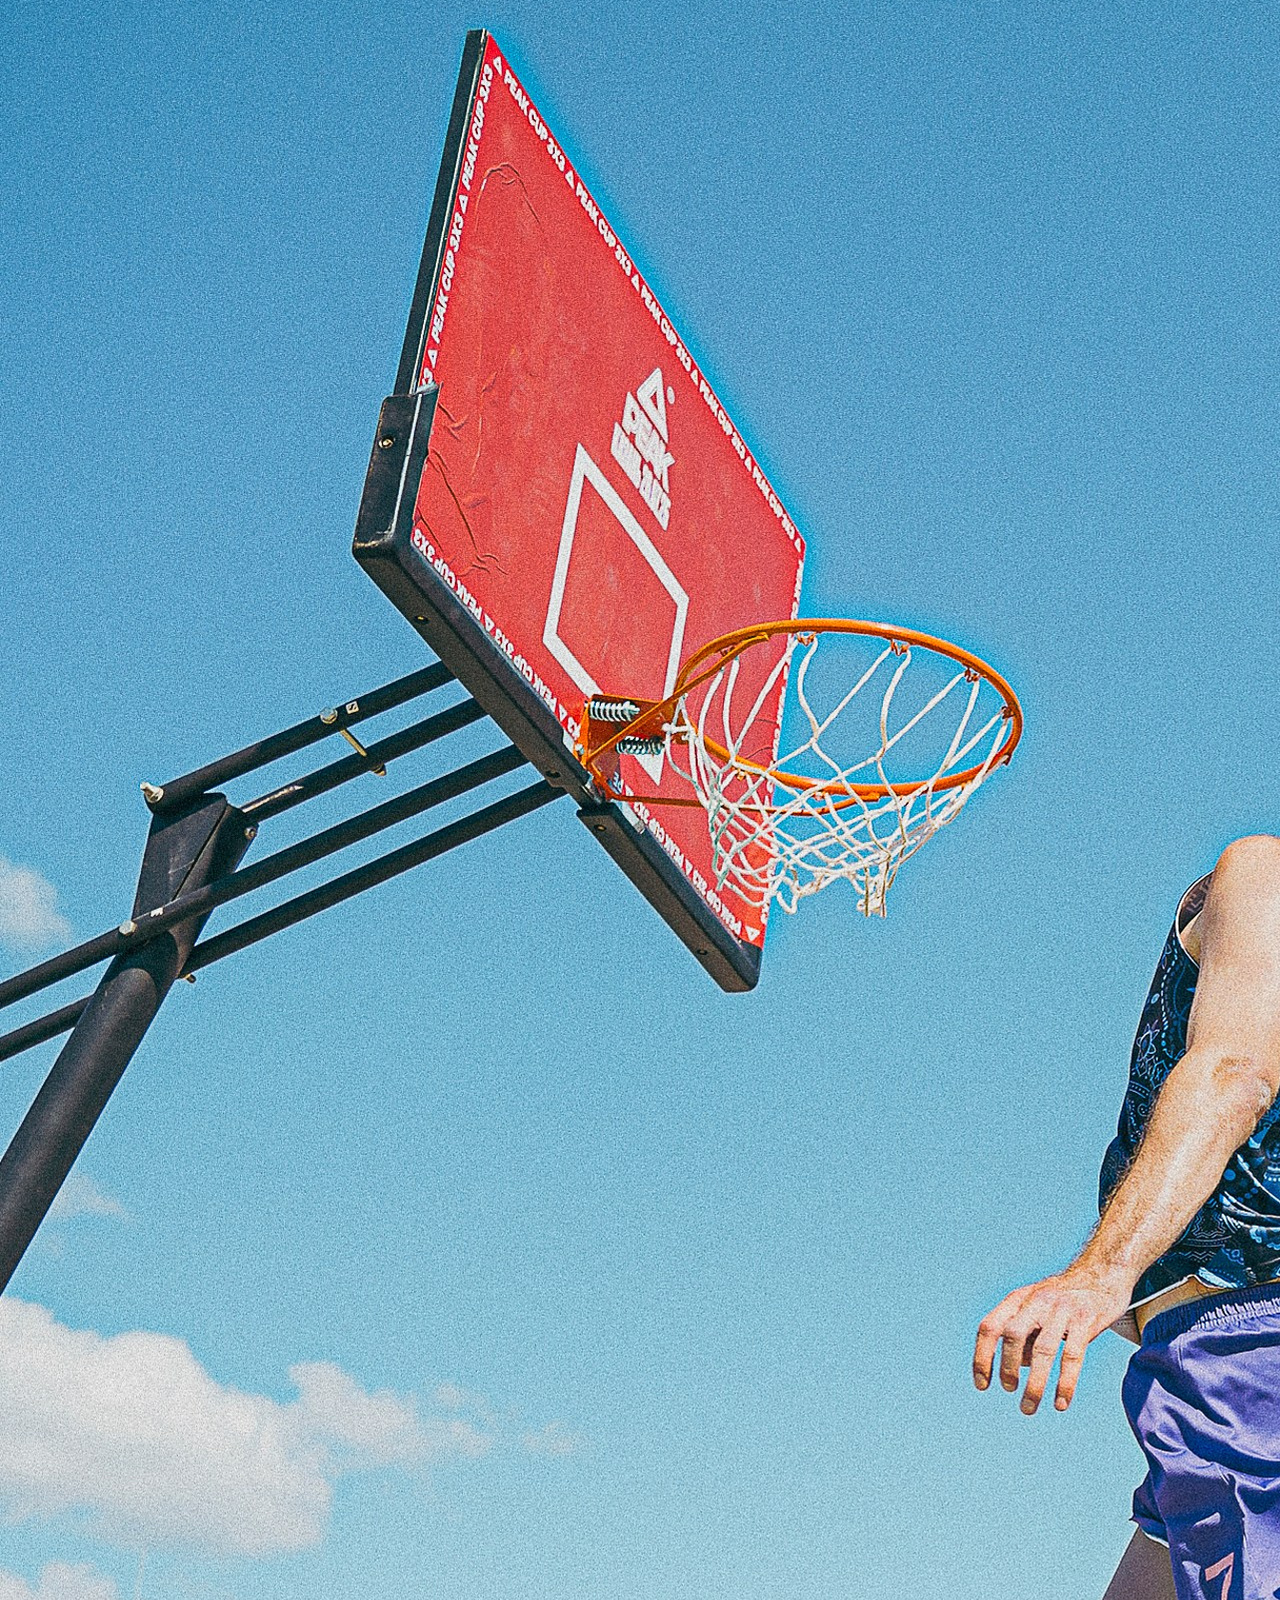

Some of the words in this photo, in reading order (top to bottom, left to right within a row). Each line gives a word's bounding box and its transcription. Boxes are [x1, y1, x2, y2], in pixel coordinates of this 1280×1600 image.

[431, 289, 449, 344] PEAK
[441, 250, 456, 291] CUP
[461, 137, 479, 191] PEAK
[471, 100, 485, 140] CUP
[504, 69, 529, 116] PEAK
[528, 108, 548, 141] CUP
[575, 181, 600, 227] PEAK
[598, 218, 617, 248] CUP
[621, 391, 676, 494] PEAK
[434, 558, 456, 588] CUP
